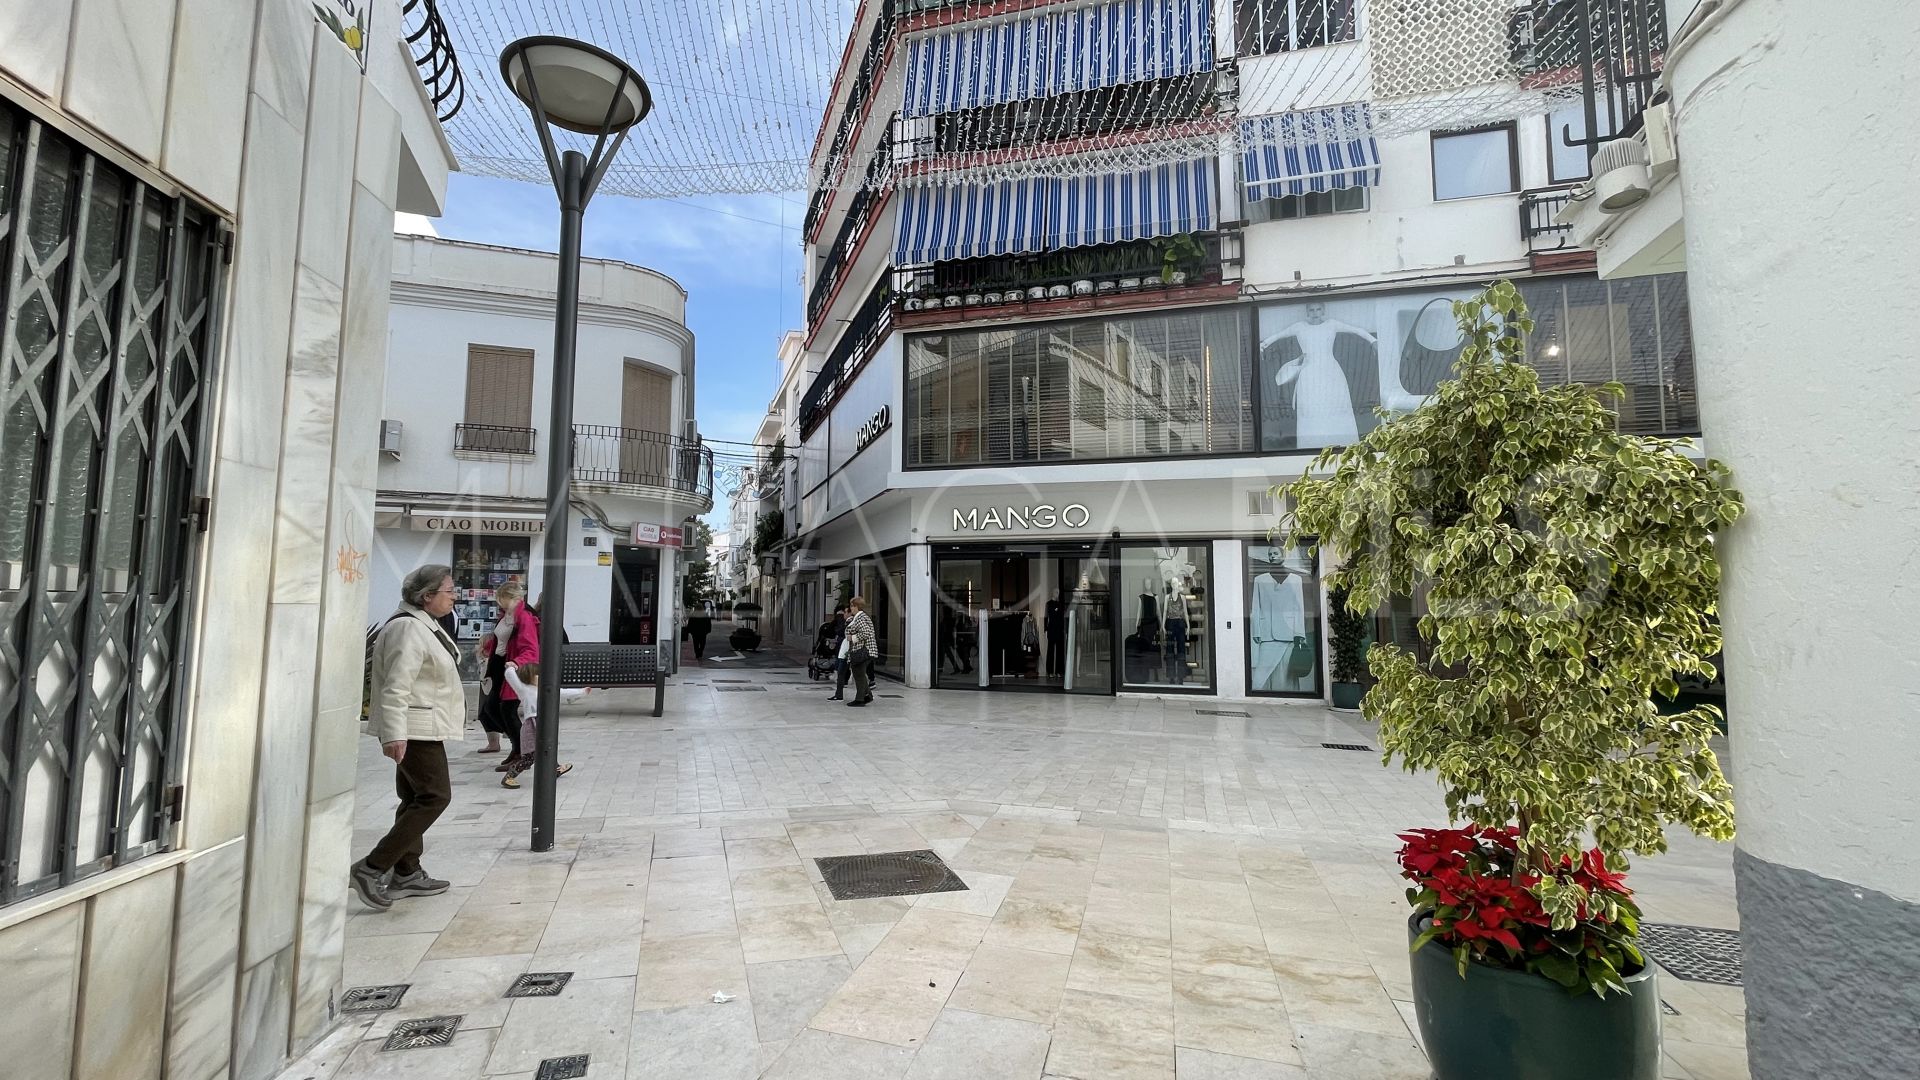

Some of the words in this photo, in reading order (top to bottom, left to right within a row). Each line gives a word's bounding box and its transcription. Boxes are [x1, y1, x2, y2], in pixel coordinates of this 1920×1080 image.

[855, 404, 888, 451] MANGO
[426, 518, 472, 530] CIAO
[953, 504, 1090, 531] MANGO
